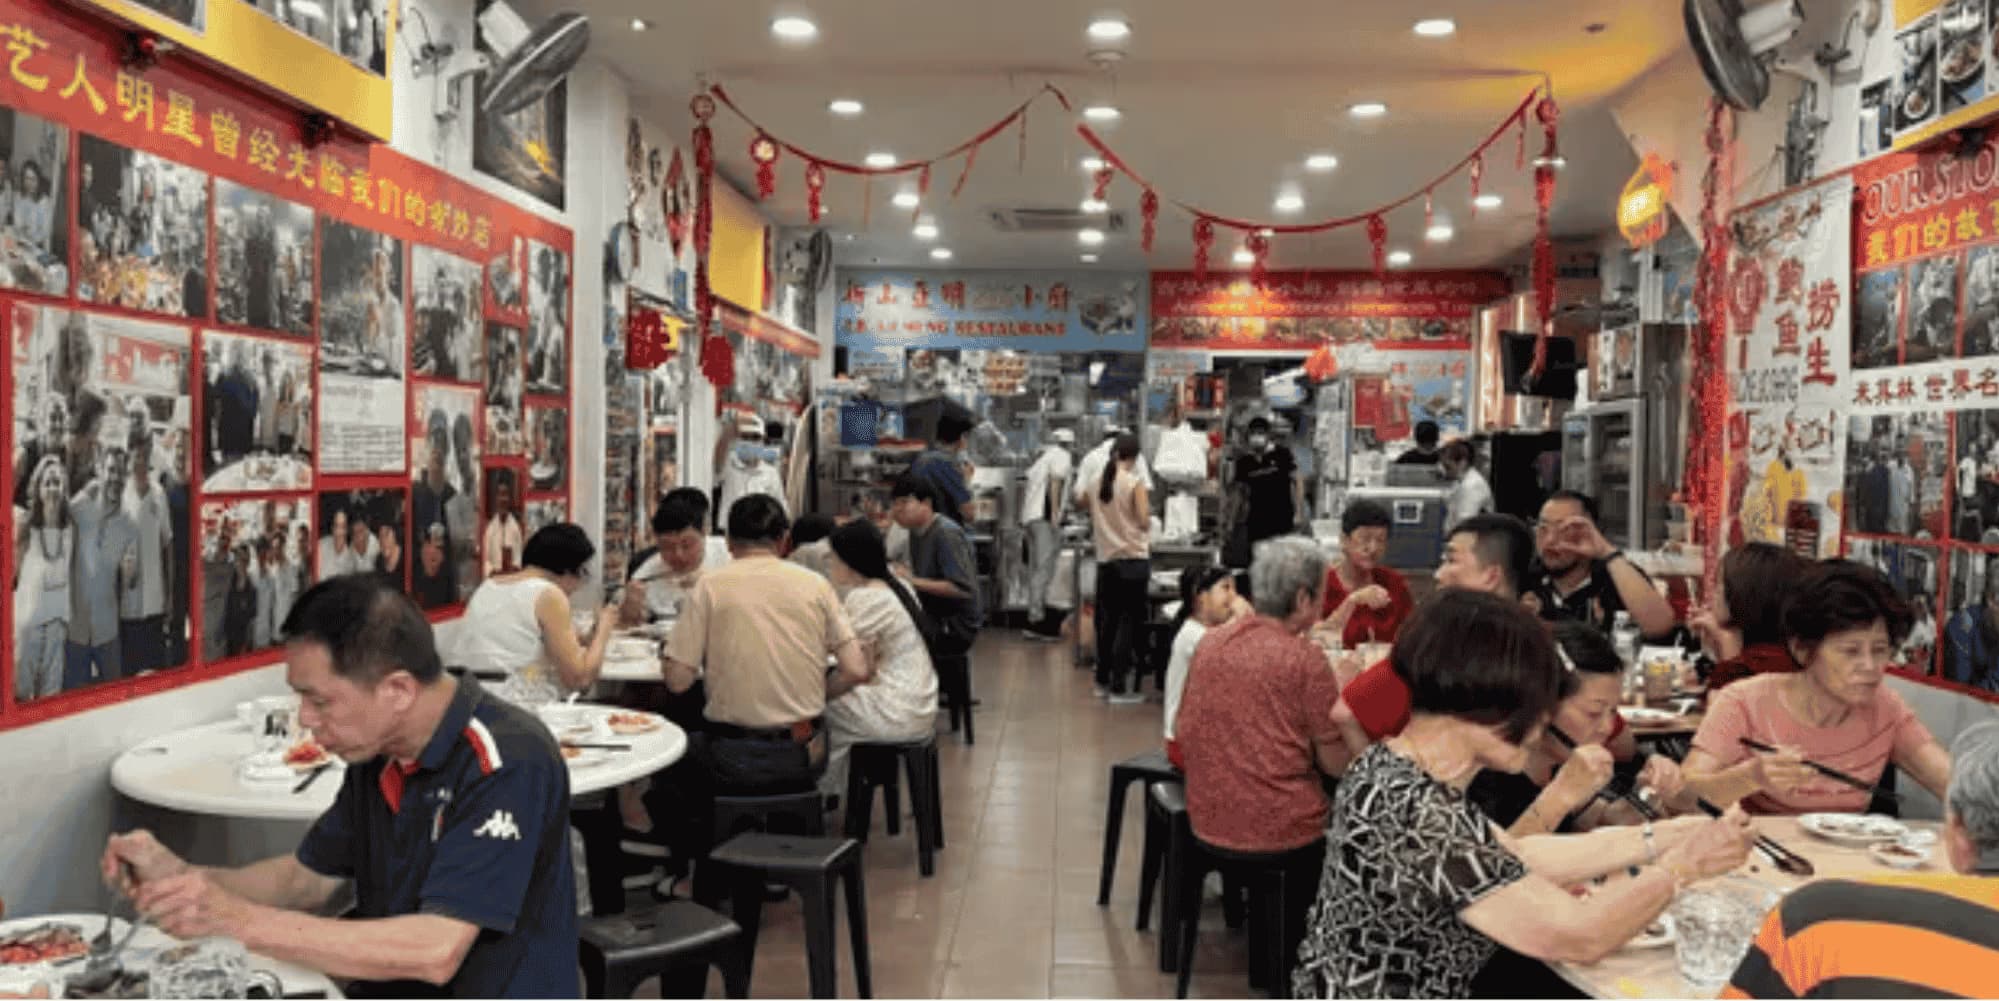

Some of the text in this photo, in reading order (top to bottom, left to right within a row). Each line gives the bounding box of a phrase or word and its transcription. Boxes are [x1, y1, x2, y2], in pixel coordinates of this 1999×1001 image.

[1861, 144, 1999, 225] OUR STO
[1802, 277, 1841, 386] 捞生
